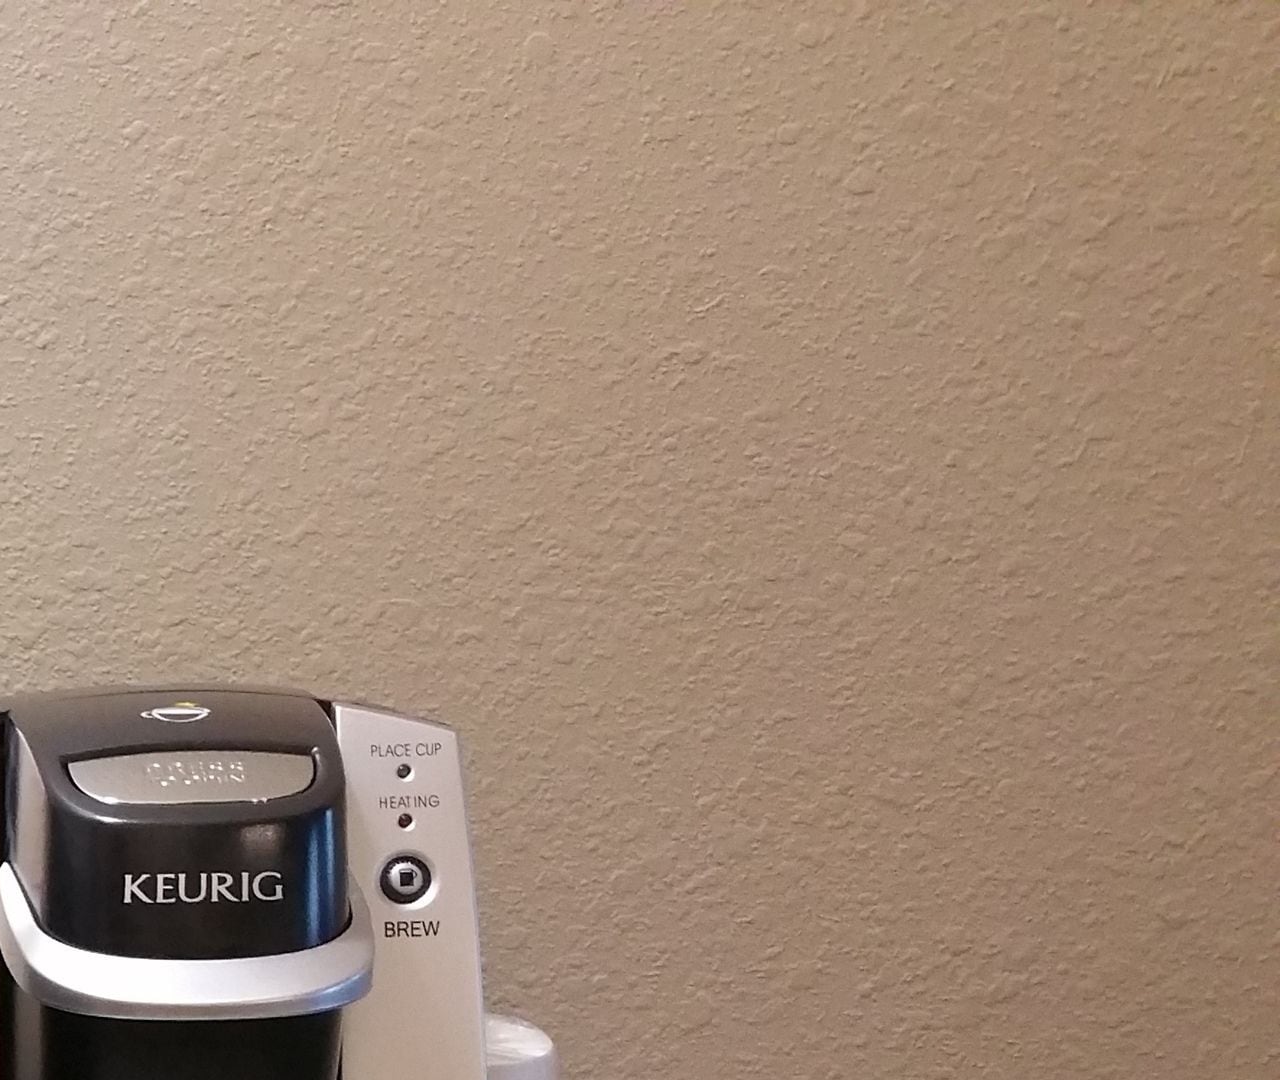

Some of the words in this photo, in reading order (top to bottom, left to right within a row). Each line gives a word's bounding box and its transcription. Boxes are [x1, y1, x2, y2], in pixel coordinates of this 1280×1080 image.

[370, 743, 411, 758] PLACE
[415, 742, 442, 757] CUP
[379, 794, 440, 809] HEATING
[123, 871, 284, 904] KEURIG
[384, 920, 440, 938] BREW
